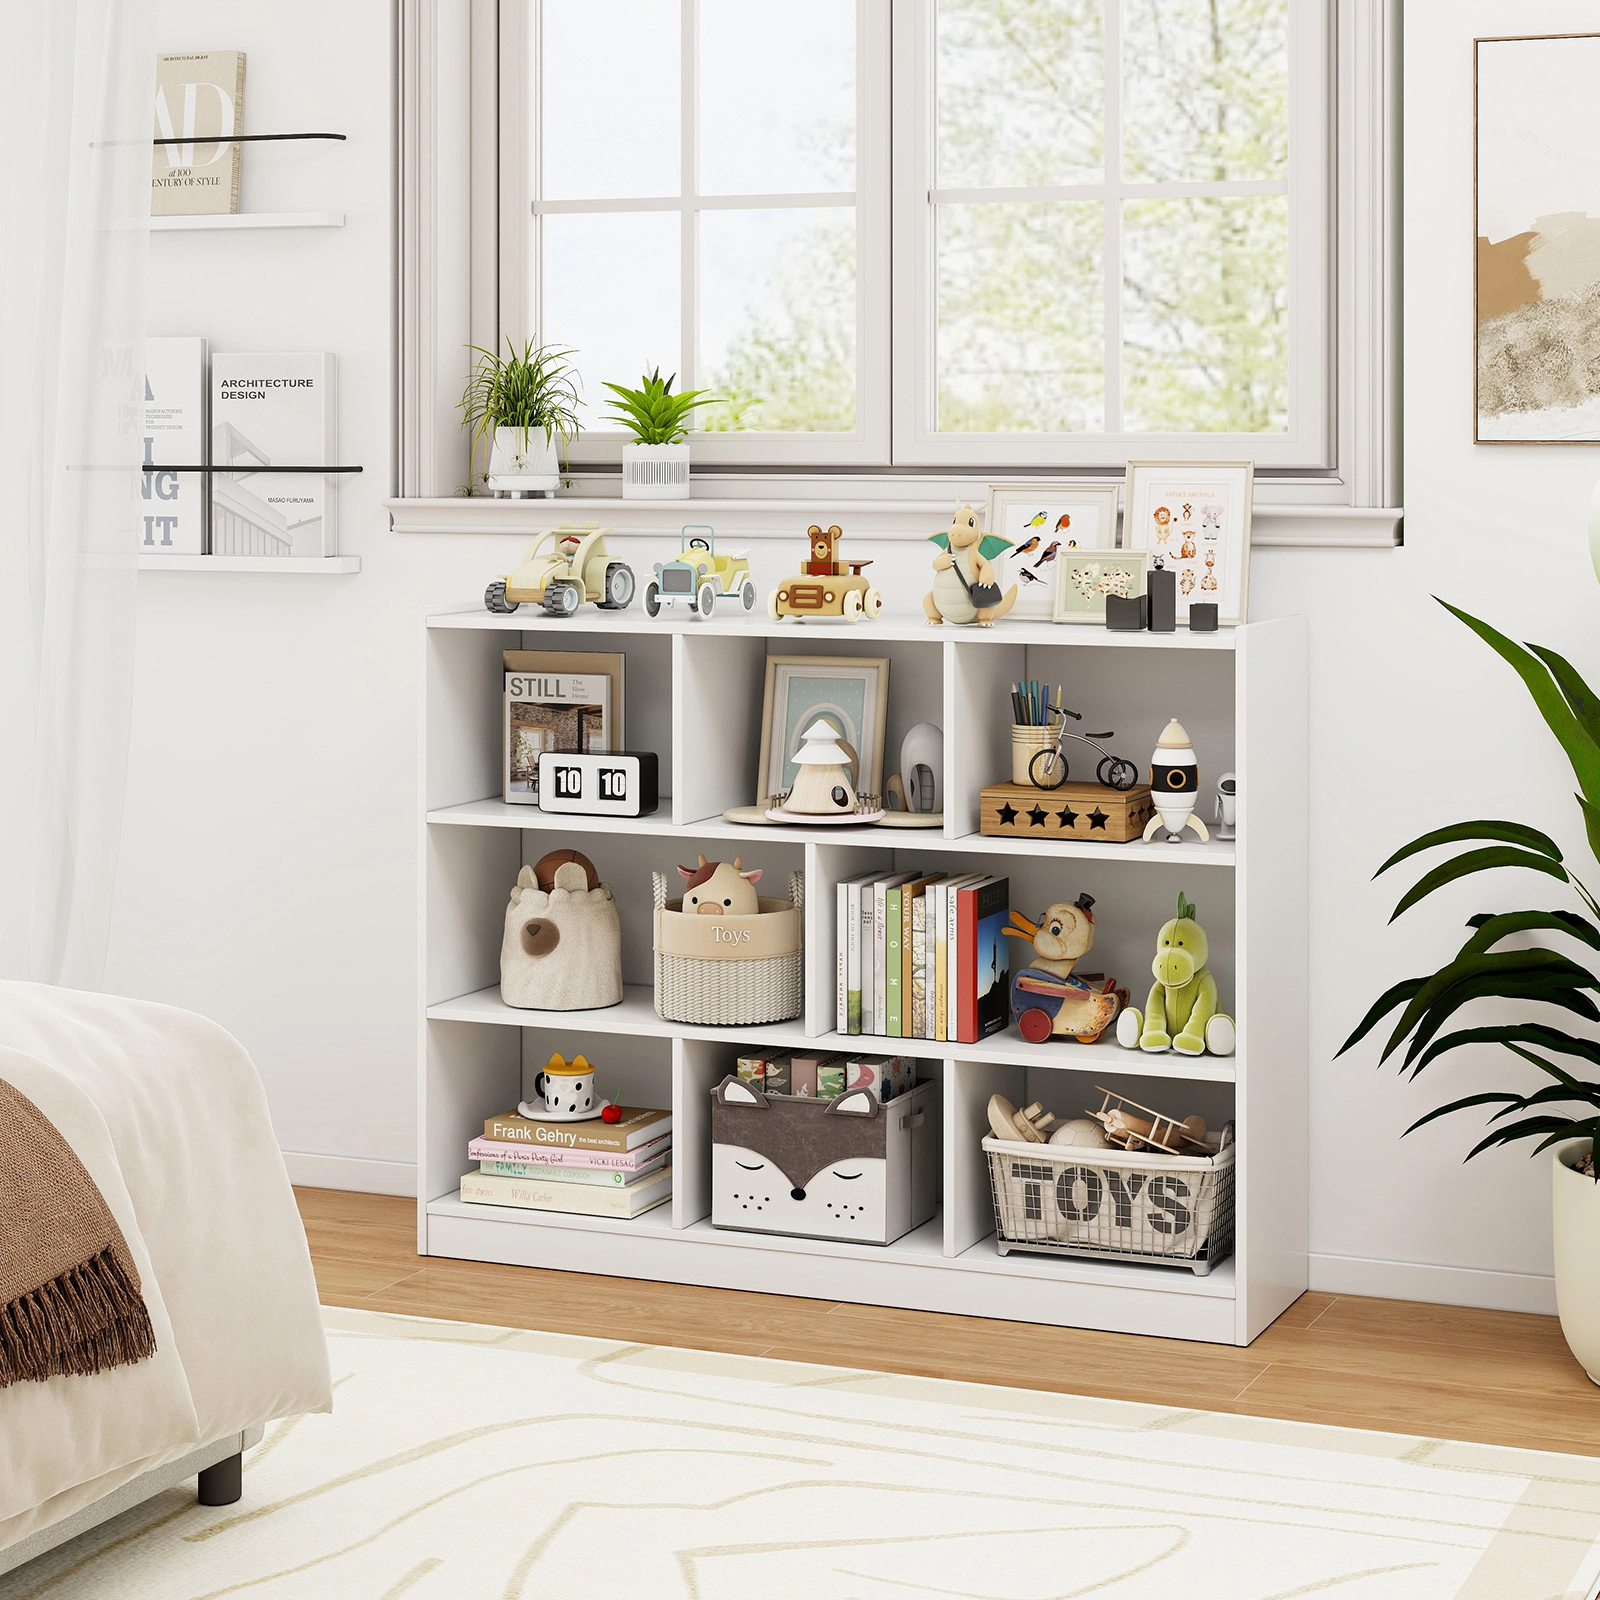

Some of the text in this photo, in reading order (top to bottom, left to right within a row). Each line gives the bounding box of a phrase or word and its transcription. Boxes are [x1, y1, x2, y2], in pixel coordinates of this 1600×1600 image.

[178, 169, 191, 177] 100
[152, 177, 221, 187] ENTURY OF STYLE
[220, 379, 314, 388] ARCHITECTURE
[221, 390, 266, 400] DESIGN
[510, 677, 566, 698] STILL
[556, 770, 626, 796] 10 10
[712, 926, 751, 947] Toys
[493, 1123, 532, 1140] Frank
[536, 1127, 577, 1147] Gehry
[500, 1151, 508, 1161] of
[589, 1158, 609, 1166] VICKI
[496, 1161, 527, 1175] FAMILY
[511, 1189, 531, 1200] Willa
[533, 1191, 553, 1203] Cather
[1011, 1162, 1191, 1235] TOYS
